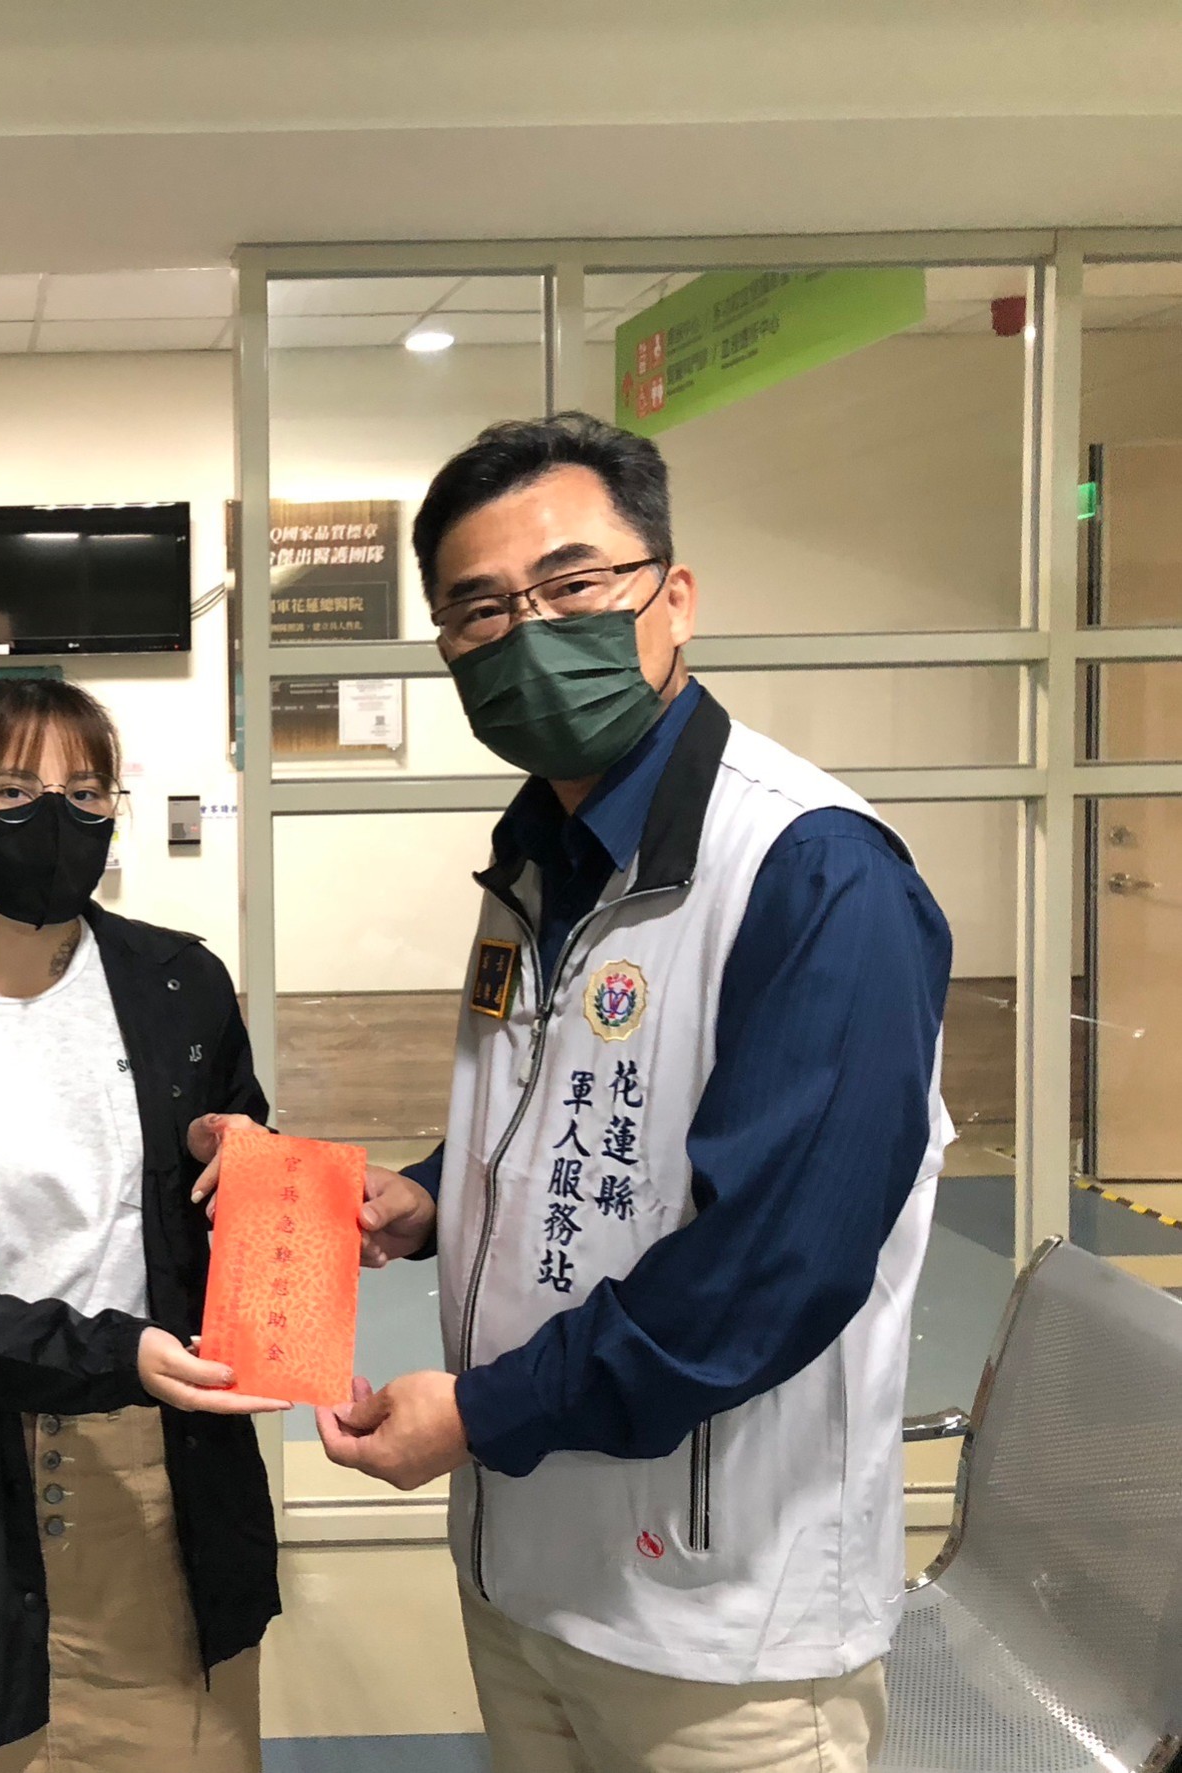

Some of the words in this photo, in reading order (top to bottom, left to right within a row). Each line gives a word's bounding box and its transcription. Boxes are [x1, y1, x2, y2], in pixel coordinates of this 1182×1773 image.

[537, 1070, 595, 1294] 軍人服務站
[595, 1060, 643, 1221] 花蓮縣
